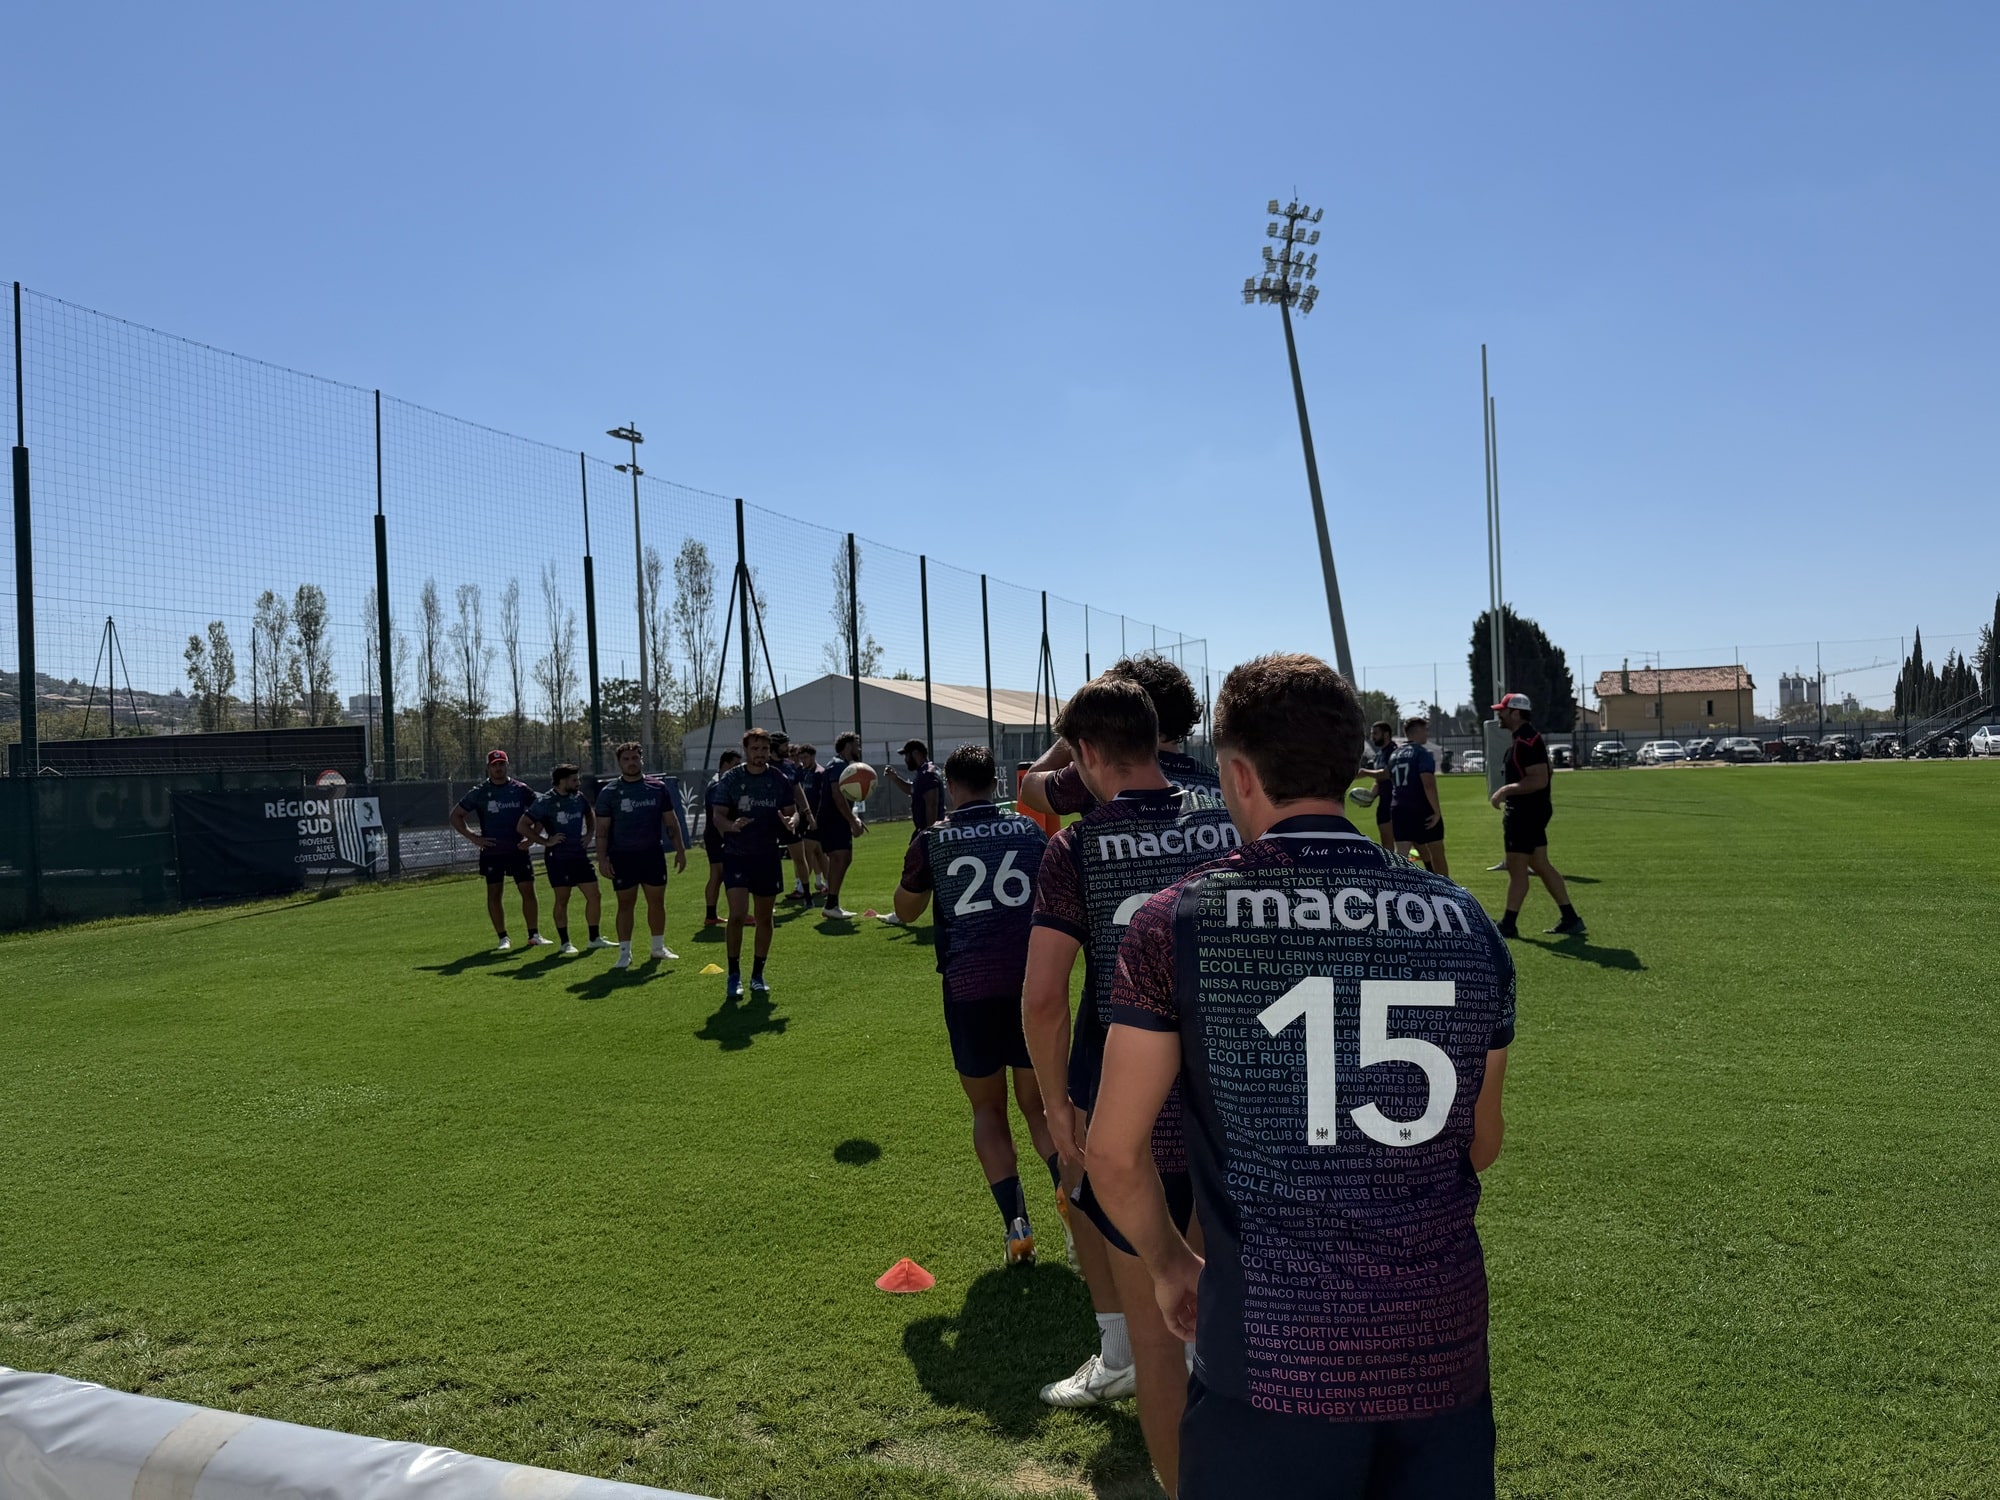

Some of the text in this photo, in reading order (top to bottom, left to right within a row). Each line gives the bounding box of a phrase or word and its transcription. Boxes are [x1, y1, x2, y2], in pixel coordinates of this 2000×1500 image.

[999, 766, 1007, 778] DE
[1391, 763, 1410, 787] 17
[993, 779, 1008, 799] CE
[264, 799, 331, 819] RÉGION
[297, 818, 332, 835] SUD
[939, 821, 1026, 843] macron
[299, 836, 334, 846] PROVENCE
[1098, 822, 1243, 861] macron
[316, 845, 335, 853] ALPES
[294, 852, 337, 863] CÔTE D'AZUR
[1105, 853, 1212, 871] RUGBY CLUB ANTIBES SOPHIA
[1133, 868, 1159, 877] LERINS
[1161, 865, 1186, 875] RUGBY
[1258, 867, 1296, 878] RUGBY
[1358, 868, 1393, 879] ANTIBES
[947, 850, 1031, 916] 26
[1089, 881, 1121, 891] ECOLE
[1122, 877, 1155, 887] RUGBY
[1282, 877, 1431, 893] STADE LAURENTIN RUGBY
[1090, 891, 1113, 900] NISSA
[1095, 899, 1123, 907] MONAC
[1226, 888, 1472, 934] macron
[1368, 927, 1384, 937] AS
[1232, 933, 1484, 952] RUGBY CLUB ANTIBES SOPHIA ANTIPOLIS
[1199, 947, 1408, 964] MANDELIEU LERINS RUGBY CLUB
[1199, 960, 1413, 979] ECOLE RUGBY WEBB ELLIS
[1410, 959, 1491, 972] CLUB OMNISPORTS
[1420, 970, 1484, 982] AS MONACO
[1199, 978, 1287, 991] NISSA RUGBY
[1208, 992, 1262, 1004] MONACO
[1208, 1006, 1237, 1014] LERINS
[1408, 1008, 1478, 1020] RUGBY CLUB
[1205, 1015, 1234, 1025] RUGBY
[1386, 1019, 1486, 1033] RUGBY OLYMPIQUE
[1206, 1024, 1248, 1038] ÉTOILE
[1449, 1033, 1486, 1045] RUGBY
[1209, 1048, 1257, 1065] ECOLE
[1256, 976, 1457, 1148] 15
[1209, 1063, 1289, 1079] NISSA RUGBY
[1407, 1074, 1422, 1084] DE
[1221, 1080, 1307, 1093] MONACO RUGBY
[1342, 1084, 1406, 1093] CLUB ANTIBES
[1240, 1096, 1289, 1104] RUGBY CLUB
[1239, 1105, 1299, 1115] CLUB ANTIBES
[1382, 1106, 1423, 1118] RUGBY
[1256, 1143, 1367, 1155] OLYMPIQUE DE GRASSE
[1368, 1145, 1429, 1158] AS MONACO
[1292, 1159, 1320, 1171] CLUB
[1323, 1158, 1373, 1170] ANTIBES
[1375, 1158, 1420, 1169] SOPHIA
[1290, 1173, 1405, 1187] LERINS RUGBY CLUB
[1406, 1176, 1429, 1185] CLUB
[1273, 1183, 1411, 1202] RUGBY WEBB ELLIS
[1279, 1206, 1321, 1217] RUGBY
[1341, 1198, 1430, 1219] OMNISPORTS DE
[1283, 1217, 1348, 1229] CLUB STADE
[1240, 1231, 1413, 1258] TOILE VILLENEUVE
[1403, 1228, 1434, 1248] RUGBY
[1241, 1254, 1439, 1278] COLE WEBB ELLIS
[1272, 1273, 1355, 1290] RUGBY CLUB
[1248, 1285, 1373, 1301] MONACO RUGBY RUGBY
[1269, 1298, 1437, 1314] RUGBY CLUB STADE LAURENTIN
[1266, 1304, 1456, 1324] CLUB ANTIBES SOPHIA ANTIPOLIS RUGBY
[1243, 1321, 1432, 1338] TOILE SPORTIVE VILLENEUVE
[1329, 1334, 1435, 1351] OMNISPORTS DE
[1247, 1349, 1409, 1367] RUGBY OLYMPIQUE DE GRASSE
[1410, 1355, 1426, 1366] AS
[1271, 1360, 1461, 1383] RUGBY CLUB ANTIBES SOPHIA
[1317, 1387, 1366, 1399] LERINS
[1369, 1383, 1414, 1398] RUGBY
[1417, 1380, 1450, 1393] CLUB
[1251, 1392, 1455, 1416] COLE RUGBY WEBB ELLIS
